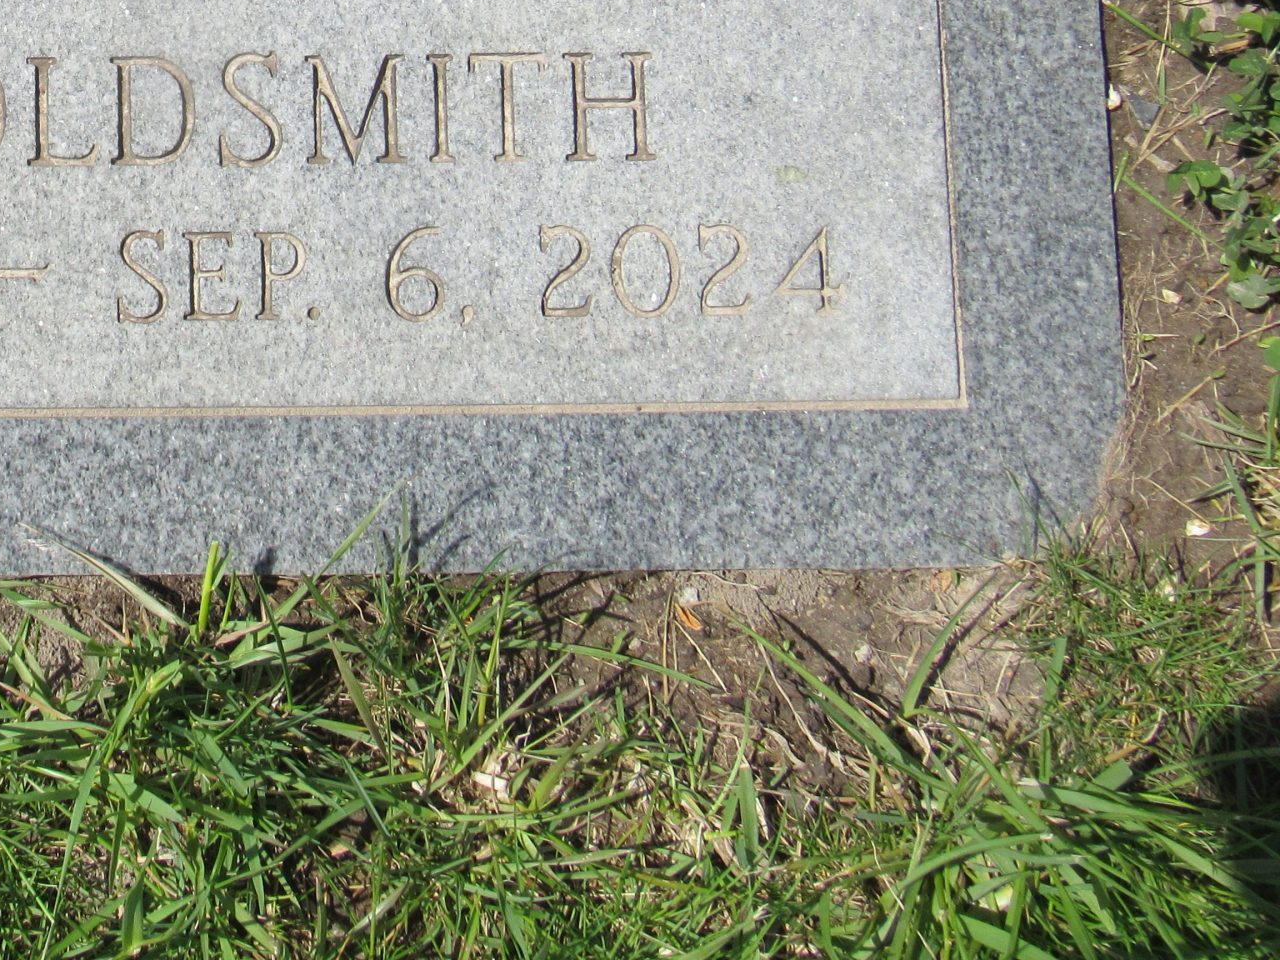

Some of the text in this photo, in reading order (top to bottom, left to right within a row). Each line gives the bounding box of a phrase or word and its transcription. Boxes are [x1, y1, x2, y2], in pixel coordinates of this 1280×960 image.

[117, 227, 321, 324] SEP.
[386, 225, 476, 325] 6,
[539, 223, 847, 318] 2024
